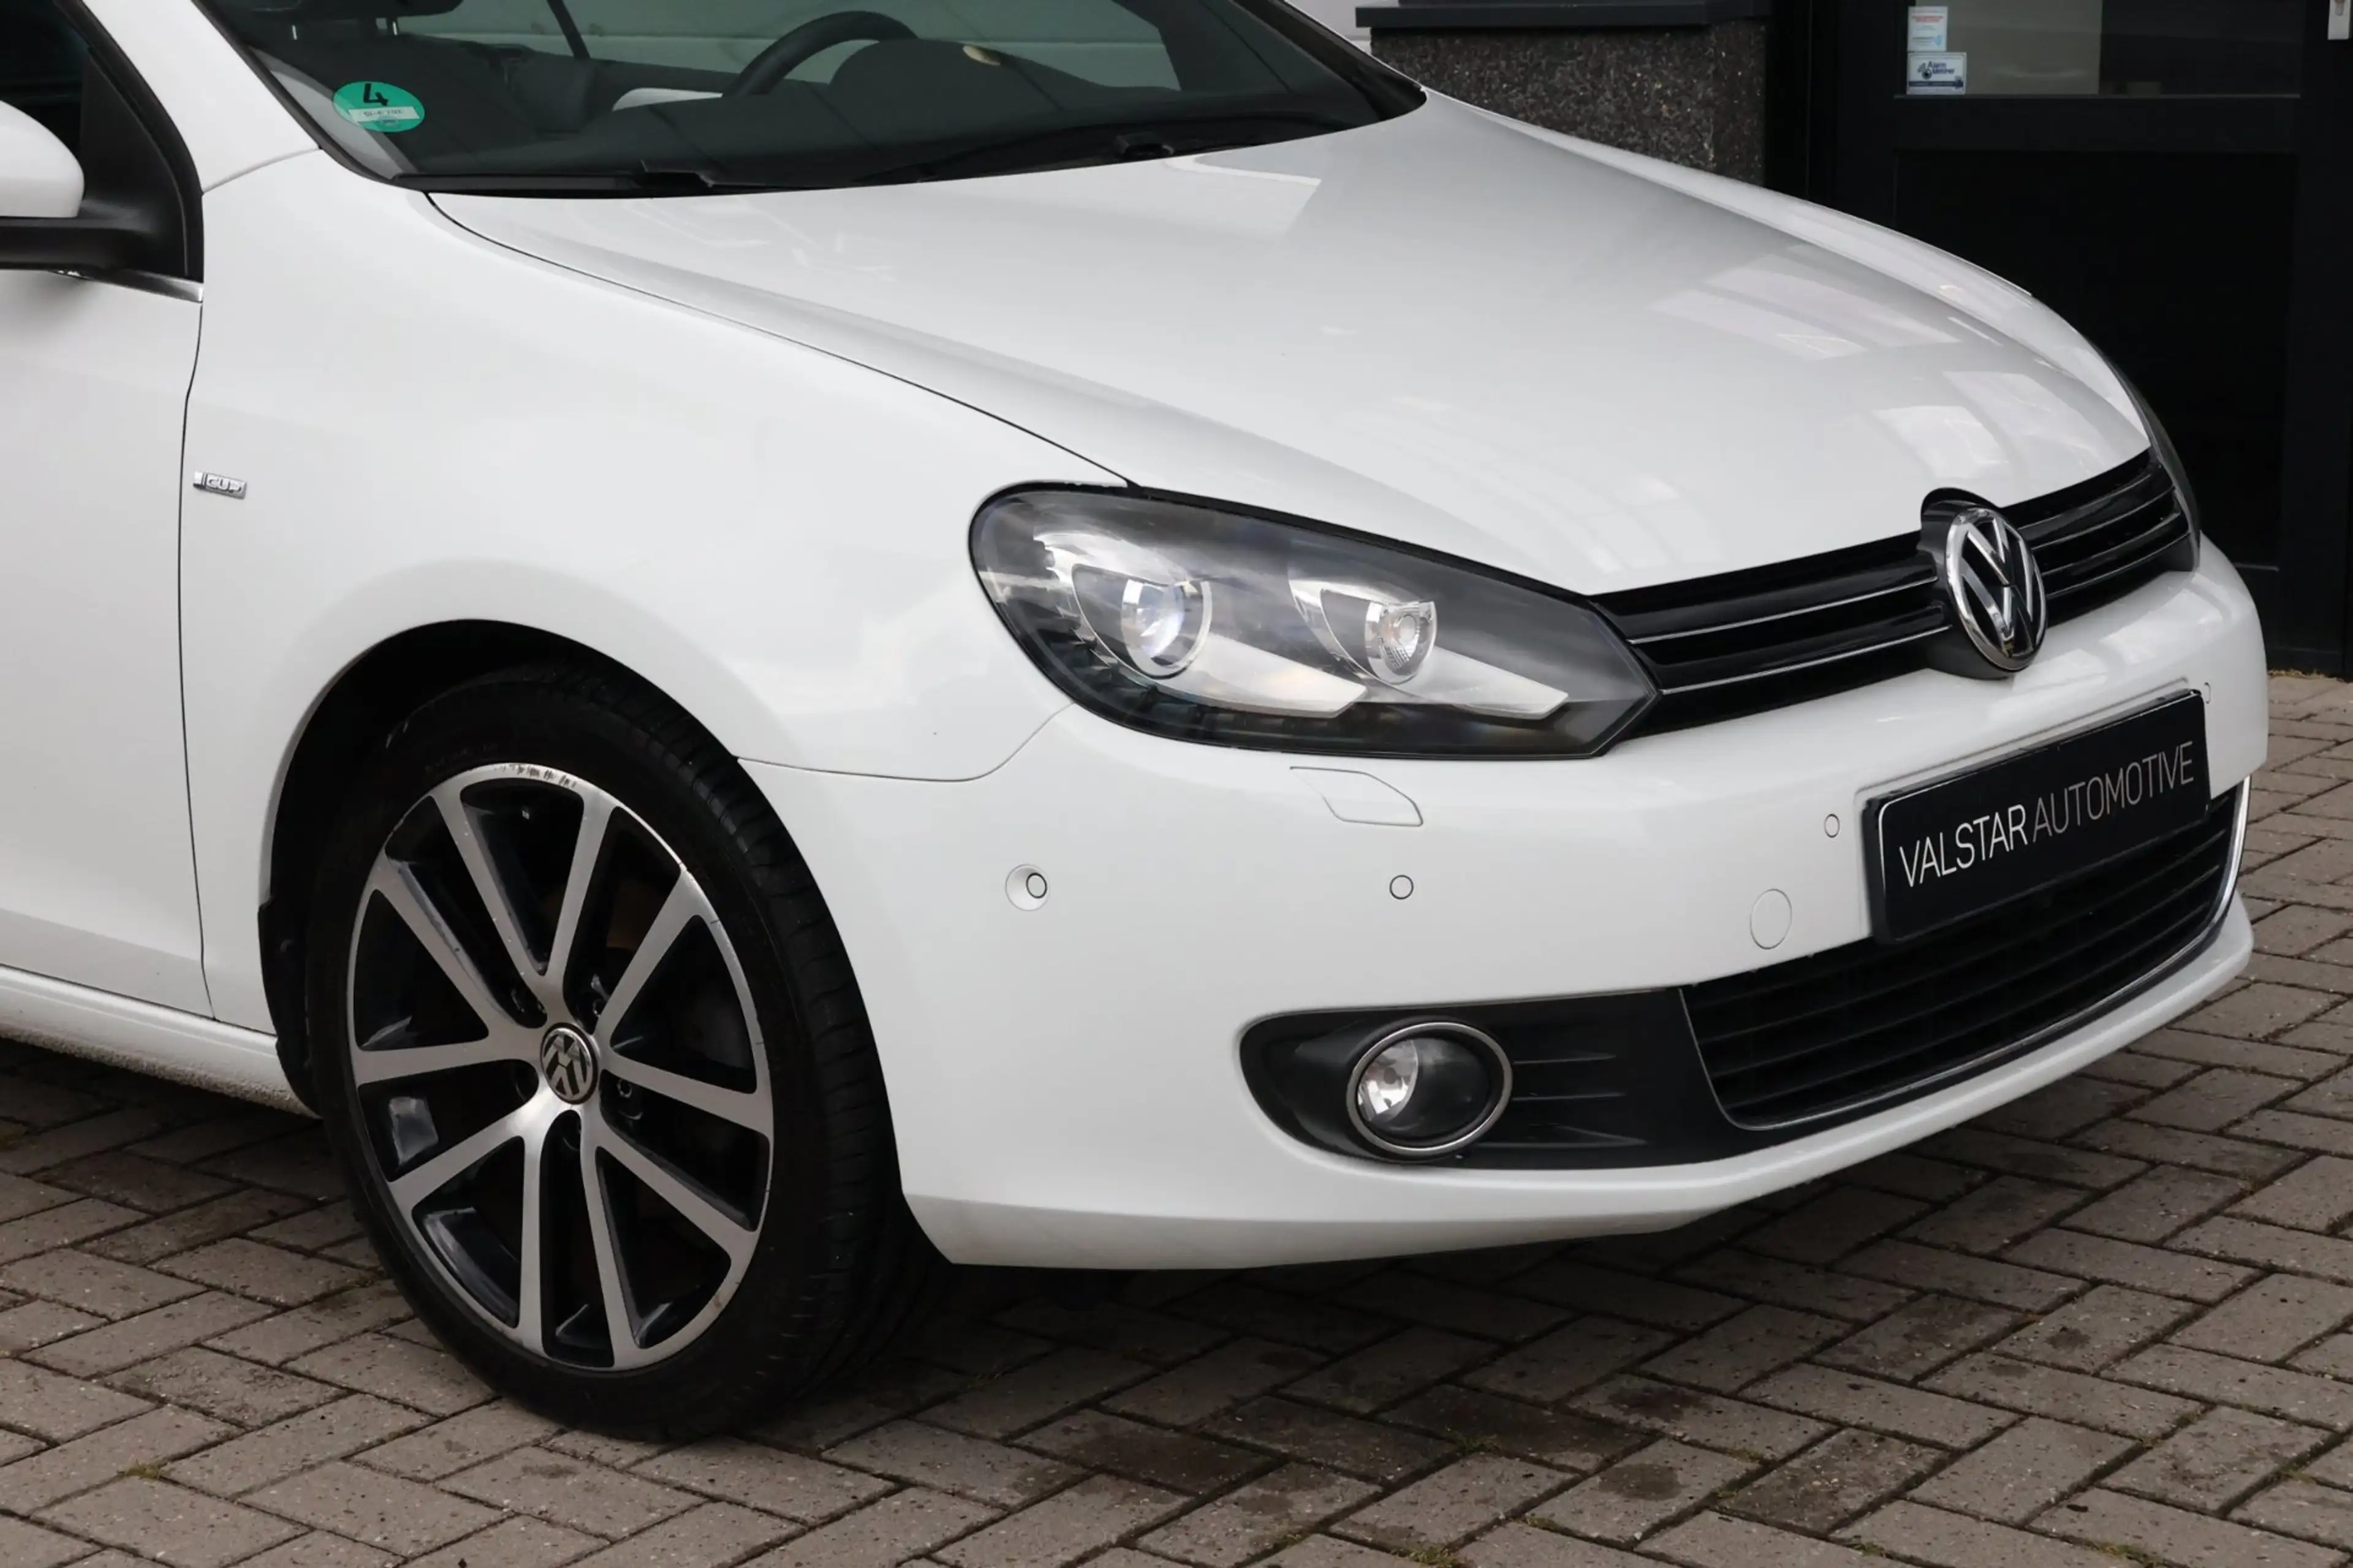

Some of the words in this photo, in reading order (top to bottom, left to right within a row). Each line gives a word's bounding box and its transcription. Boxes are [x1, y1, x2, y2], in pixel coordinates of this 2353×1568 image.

[363, 83, 388, 106] 4
[1900, 803, 2028, 887] VALSTAR
[2033, 741, 2194, 842] AUTOMOTIVE
